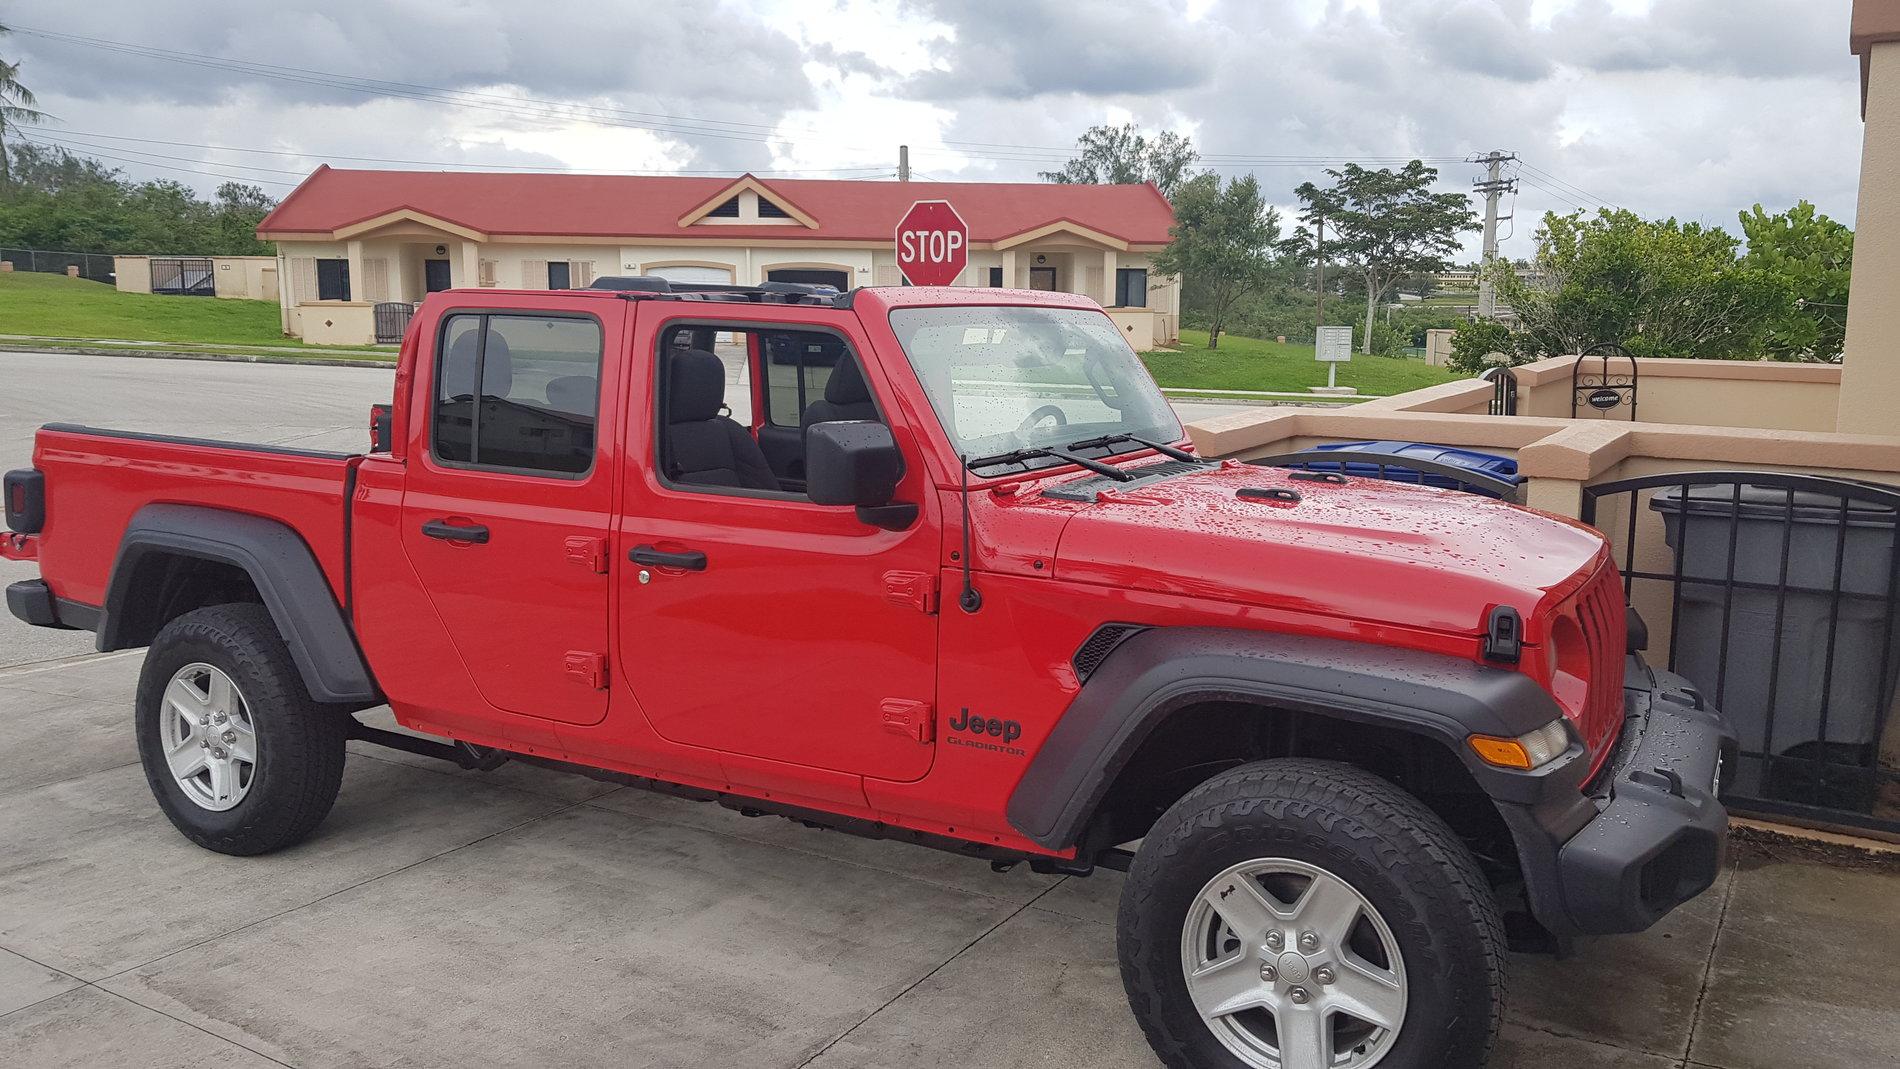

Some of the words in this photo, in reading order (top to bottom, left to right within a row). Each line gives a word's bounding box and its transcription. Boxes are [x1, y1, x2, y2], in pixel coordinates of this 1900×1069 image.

[901, 230, 963, 263] STOP
[949, 707, 1022, 744] Jeep
[946, 736, 1026, 757] GLADIATOR
